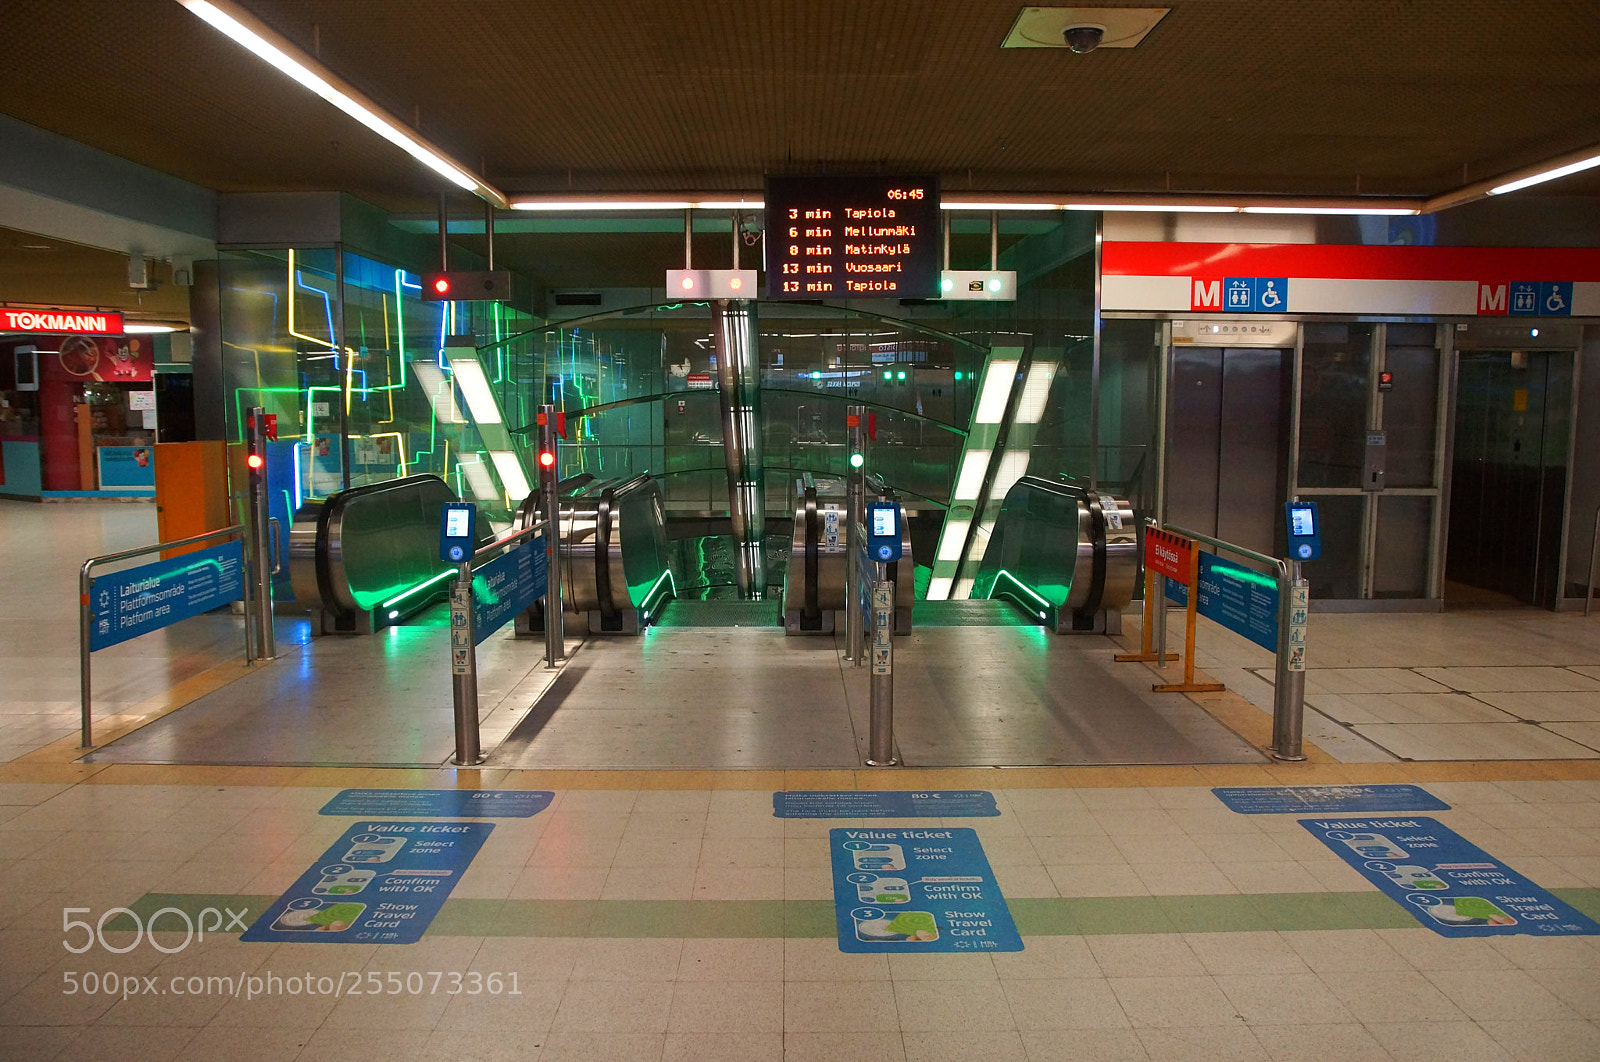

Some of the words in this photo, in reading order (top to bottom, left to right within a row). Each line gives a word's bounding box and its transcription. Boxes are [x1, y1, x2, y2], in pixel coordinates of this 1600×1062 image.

[887, 188, 924, 200] 06:45
[788, 208, 798, 220] 3
[805, 208, 832, 220] min
[844, 207, 896, 220] Tapiola
[788, 226, 798, 238] 6
[805, 226, 832, 238] min
[844, 225, 916, 238] Mellunmäki
[789, 244, 799, 256] 8
[805, 244, 832, 256] min
[844, 243, 911, 256] Matinkylä
[782, 263, 800, 274] 13
[806, 263, 833, 274] min
[845, 262, 903, 274] Vuosaari
[782, 281, 800, 292] 13
[806, 281, 833, 292] min
[846, 280, 898, 292] Tapiola
[1193, 280, 1220, 307] M
[1479, 284, 1506, 310] M
[5, 312, 107, 331] TOKMANNI
[120, 576, 161, 598] Laiturialue
[120, 583, 185, 613] Plattformsområde
[120, 610, 153, 629] Platform
[154, 604, 171, 618] area
[367, 824, 415, 833] Value
[420, 825, 471, 833] ticket
[1315, 821, 1369, 829] Value
[1370, 820, 1422, 829] ticket
[845, 831, 897, 839] Value
[902, 830, 953, 839] ticket
[385, 877, 440, 885] Confirm
[1458, 878, 1492, 886] with
[1492, 878, 1516, 886] OK
[413, 885, 435, 893] OK
[923, 884, 981, 892] Confirm
[926, 892, 958, 900] with
[961, 892, 984, 900] OK
[1495, 895, 1538, 903] Show
[299, 900, 312, 908] 3
[377, 902, 419, 911] Show
[1506, 903, 1555, 911] Travel
[372, 911, 416, 919] Travel
[944, 910, 986, 919] Show
[1520, 912, 1559, 920] Card
[364, 920, 401, 928] Card
[947, 919, 993, 927] Travel
[950, 928, 987, 937] Card
